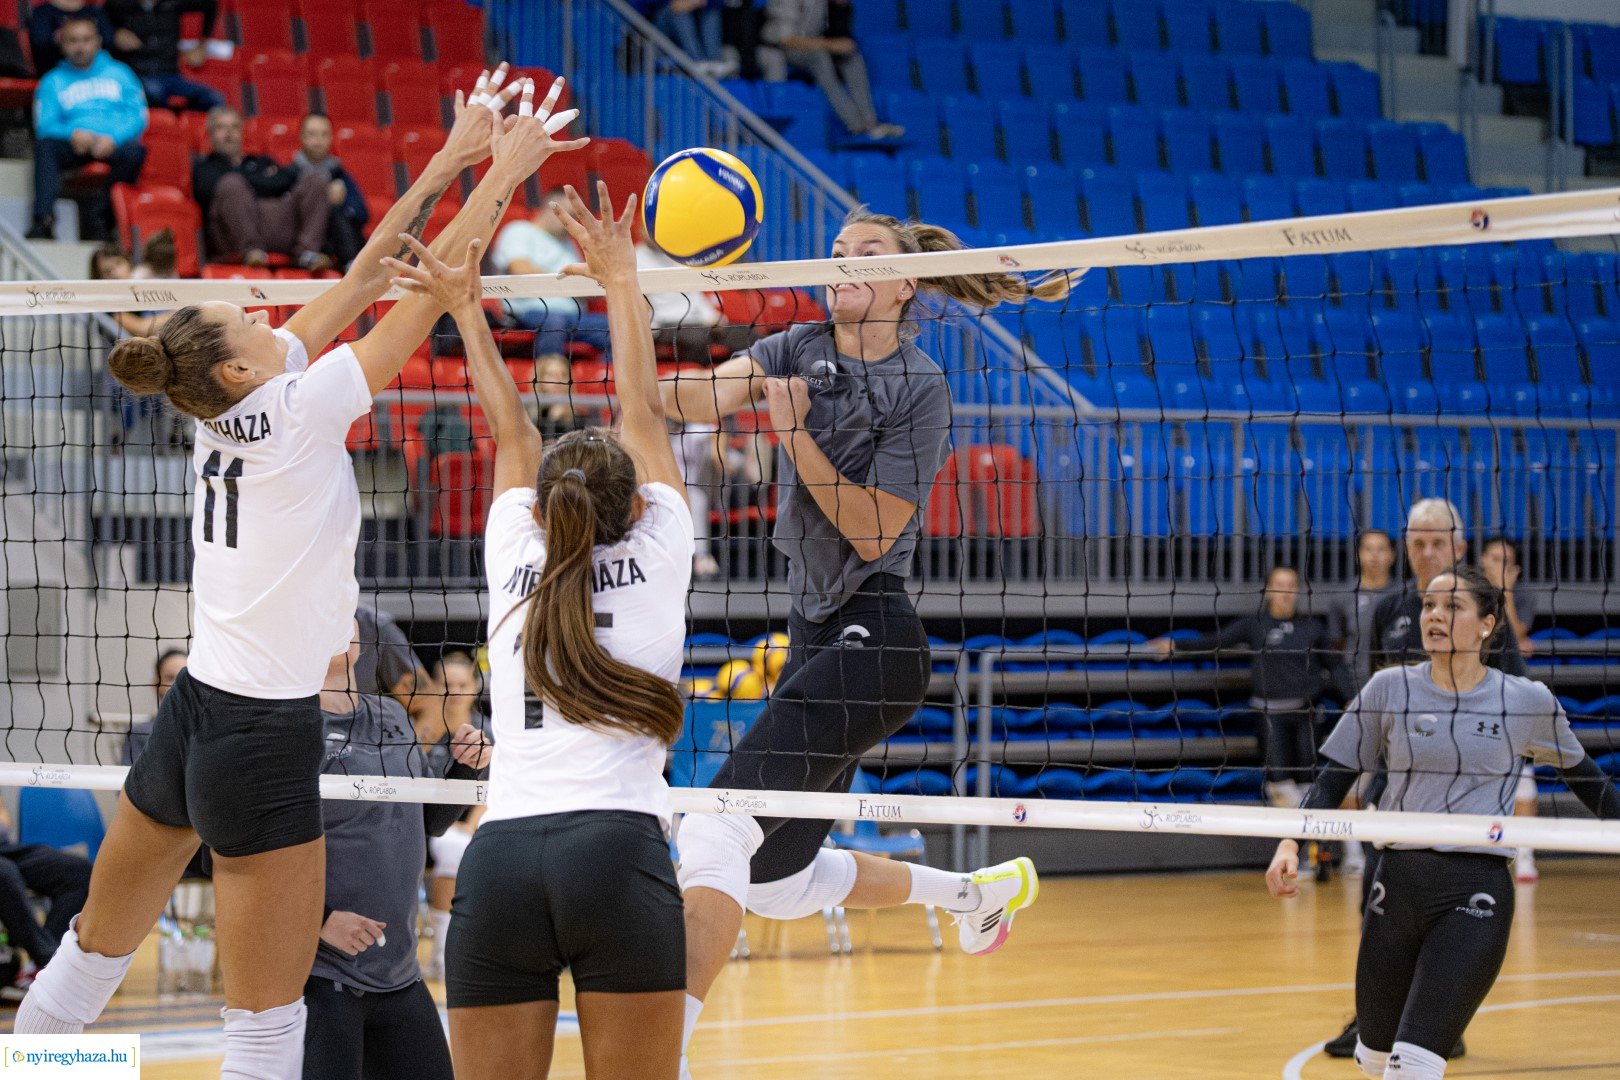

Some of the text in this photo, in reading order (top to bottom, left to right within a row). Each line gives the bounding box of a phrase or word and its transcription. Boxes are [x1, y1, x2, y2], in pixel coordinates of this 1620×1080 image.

[1282, 228, 1352, 247] FATUM
[837, 264, 901, 278] FATUM
[130, 286, 178, 303] FATUM
[201, 449, 244, 549] 11
[858, 799, 902, 818] FATUM
[1301, 813, 1353, 835] FATUM
